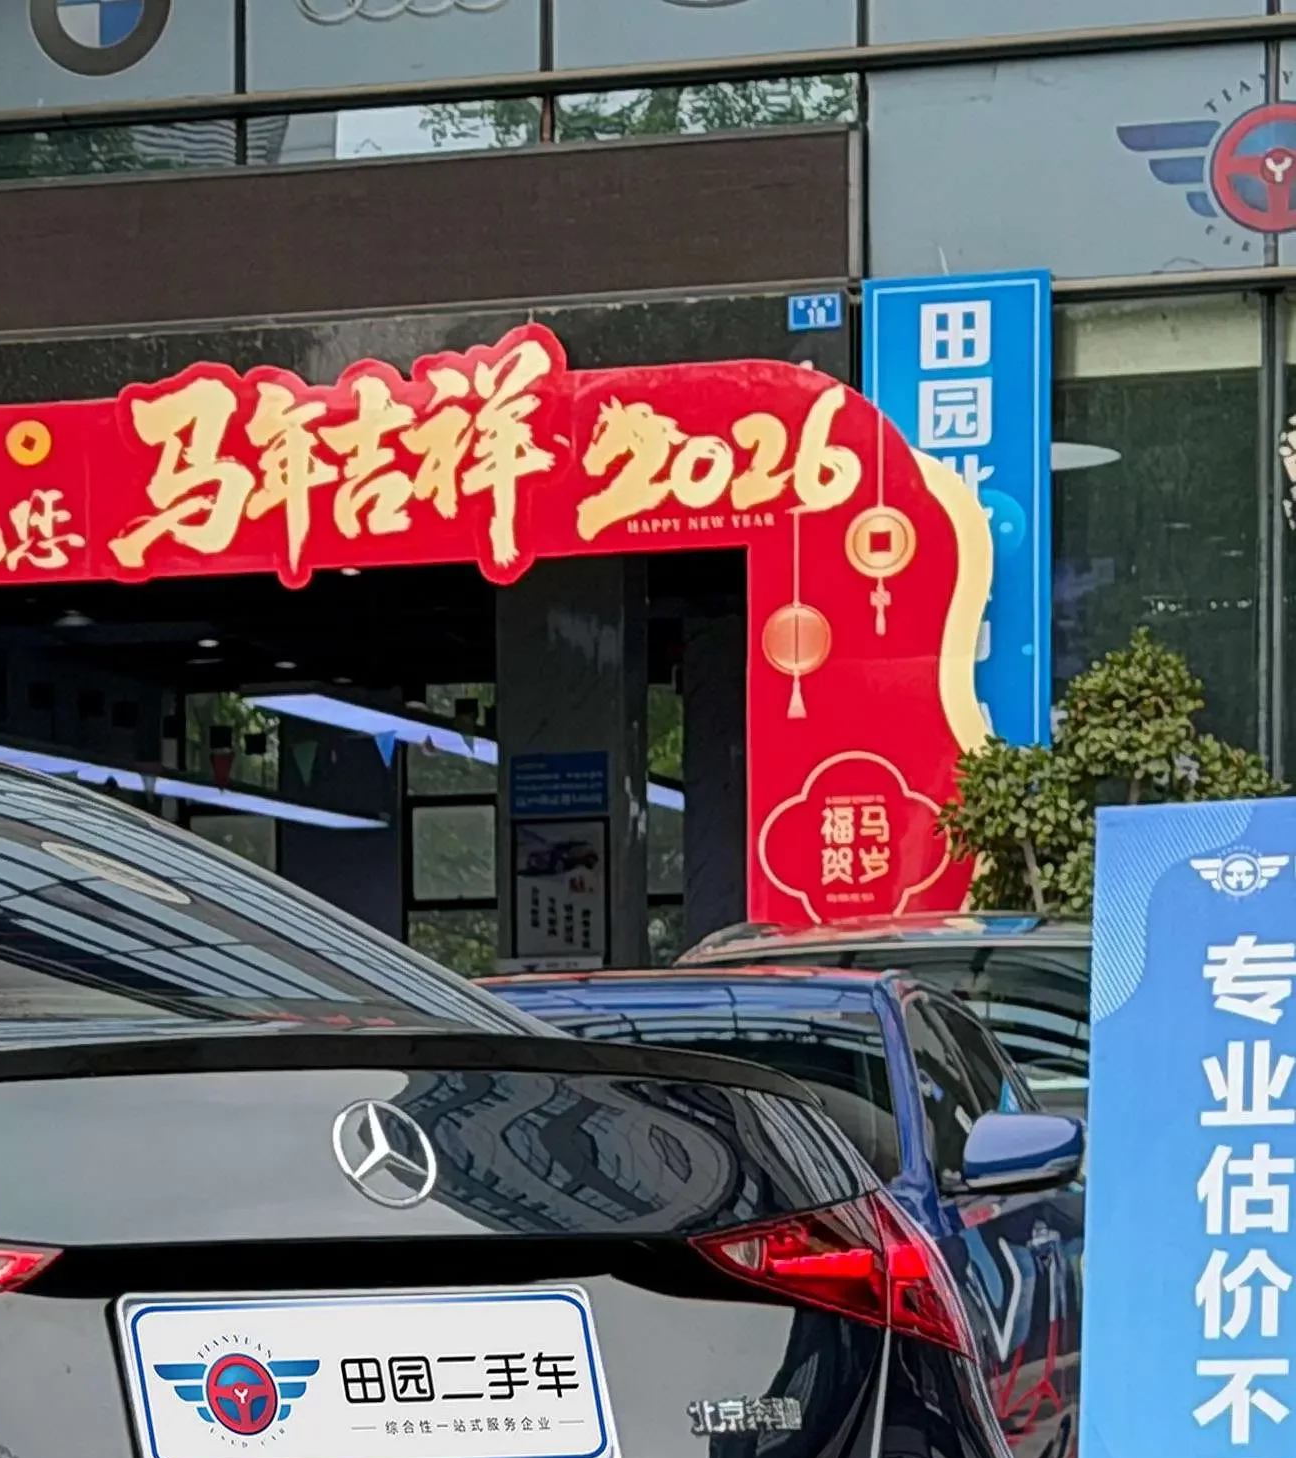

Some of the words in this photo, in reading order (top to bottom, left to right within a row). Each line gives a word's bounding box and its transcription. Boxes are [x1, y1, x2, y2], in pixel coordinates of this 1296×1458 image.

[106, 341, 557, 577] 马年吉祥
[577, 384, 862, 542] 2026
[627, 517, 681, 535] HAPPY
[688, 514, 725, 531] NEW
[731, 511, 775, 529] YEAR
[821, 846, 890, 886] 贺岁
[340, 1352, 580, 1404] 田园二手车
[384, 1415, 552, 1436] 综合性一站式服务企业
